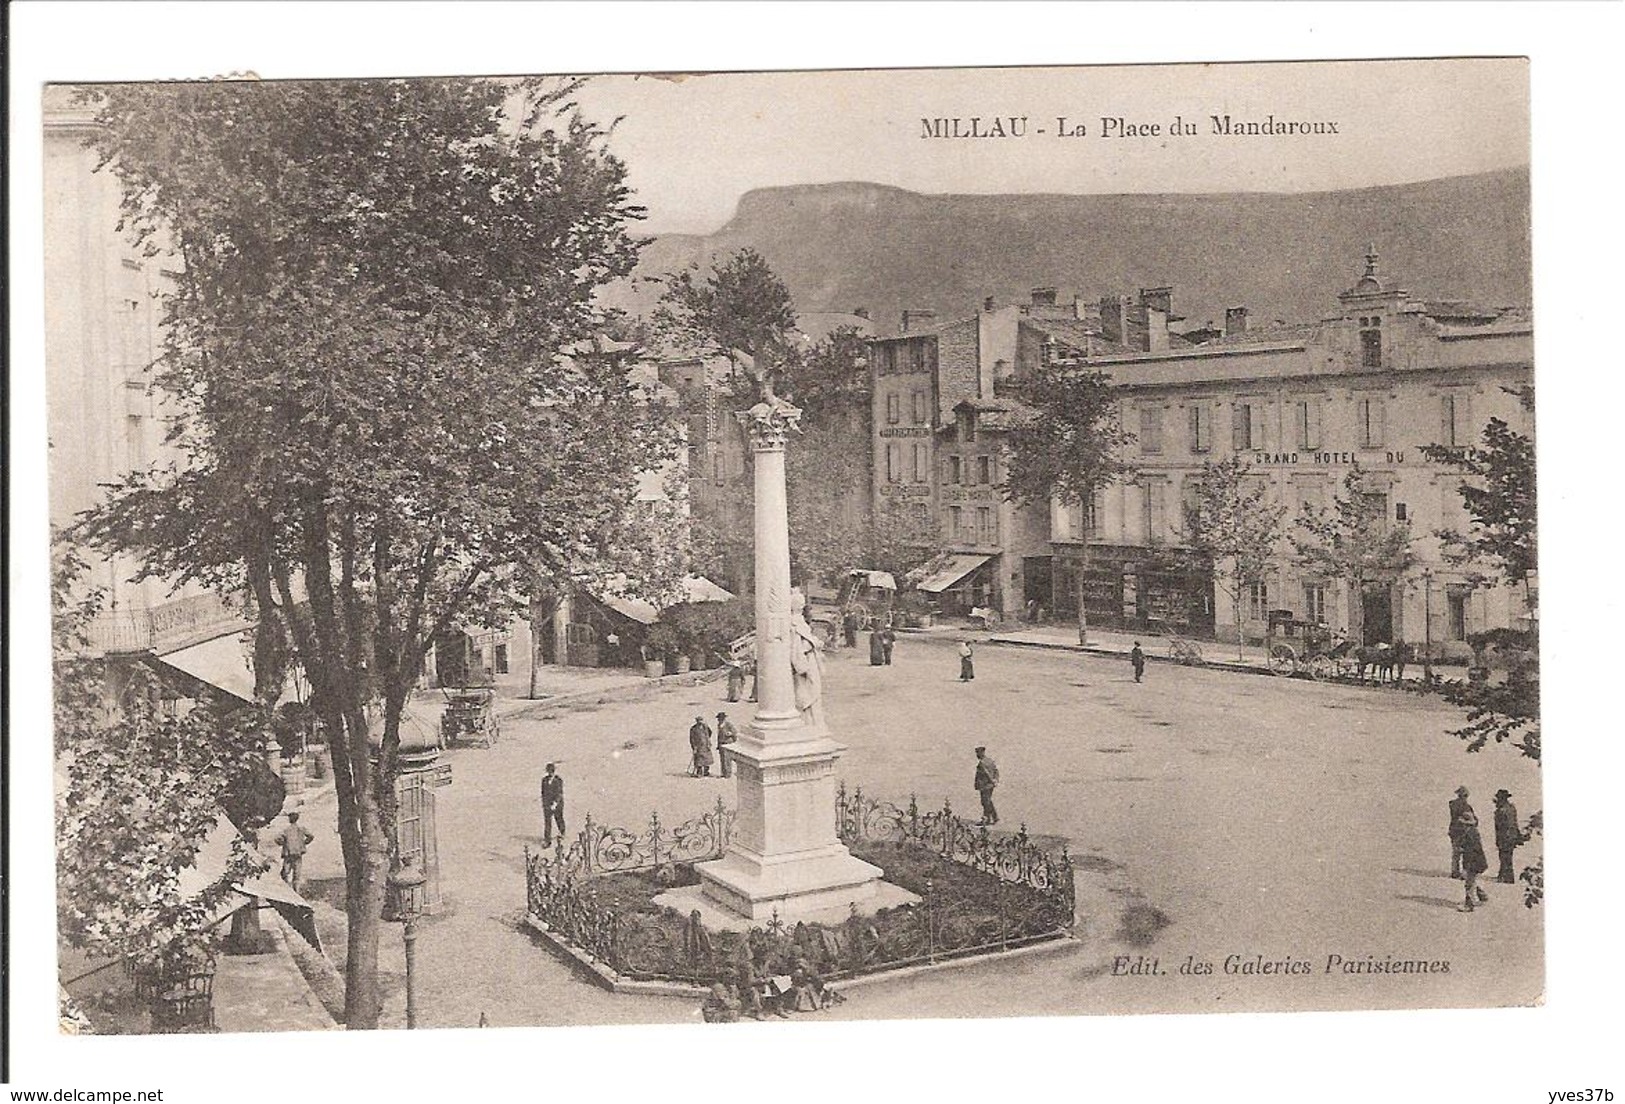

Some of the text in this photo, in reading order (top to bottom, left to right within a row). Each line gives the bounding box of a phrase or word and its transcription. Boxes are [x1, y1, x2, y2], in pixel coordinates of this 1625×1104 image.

[1255, 451, 1405, 464] GRAND HOTEL DU
